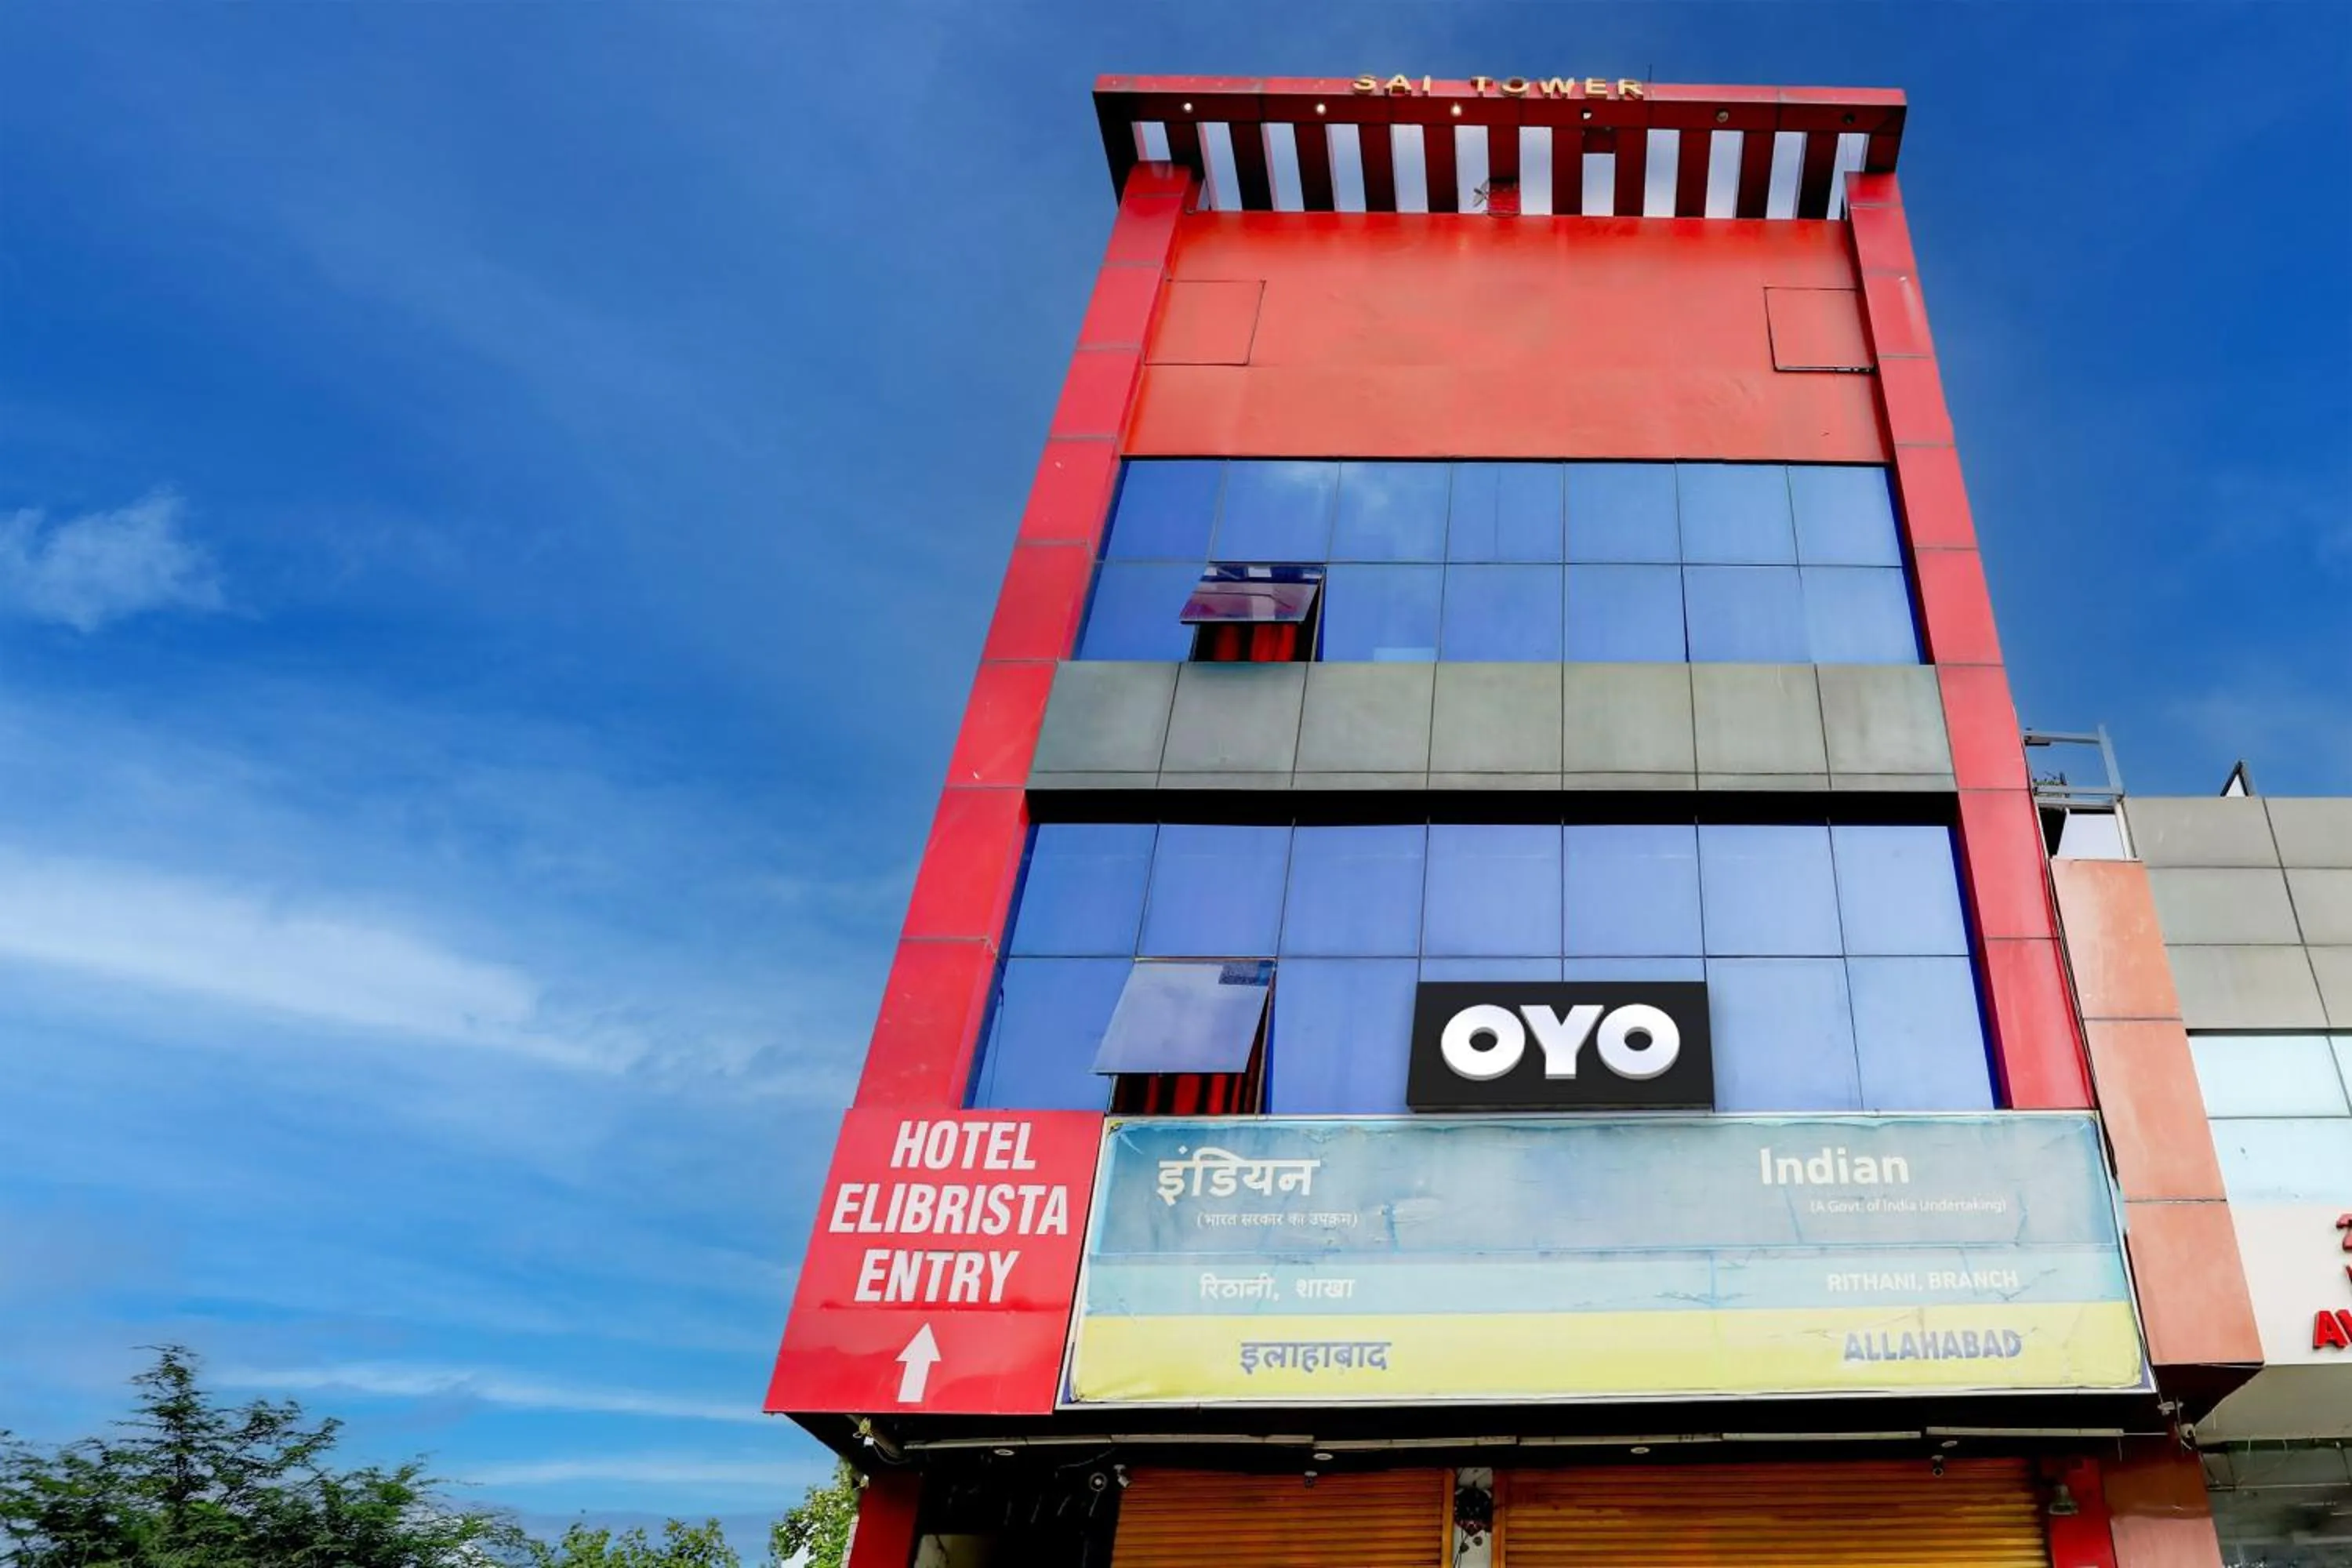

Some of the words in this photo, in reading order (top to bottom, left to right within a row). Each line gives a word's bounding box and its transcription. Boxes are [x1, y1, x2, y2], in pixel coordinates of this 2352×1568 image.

[1352, 74, 1431, 96] SAI
[1471, 75, 1644, 100] TOWER
[1441, 1004, 1680, 1081] OYO
[890, 1120, 1036, 1171] HOTEL
[1156, 1145, 1320, 1205] इंडियन
[1760, 1148, 1910, 1186] Indian
[829, 1183, 1068, 1236] ELIBRISTA
[1866, 1197, 1881, 1212] of
[1883, 1197, 1918, 1212] India
[854, 1248, 1021, 1303] ENTRY
[1295, 1277, 1356, 1299] शाखा
[1827, 1271, 1924, 1293] RITHANI,
[1928, 1269, 2019, 1290] BRANCH
[1240, 1341, 1392, 1374] इलाहाबाद
[1843, 1329, 2023, 1362] ALLAHABAD
